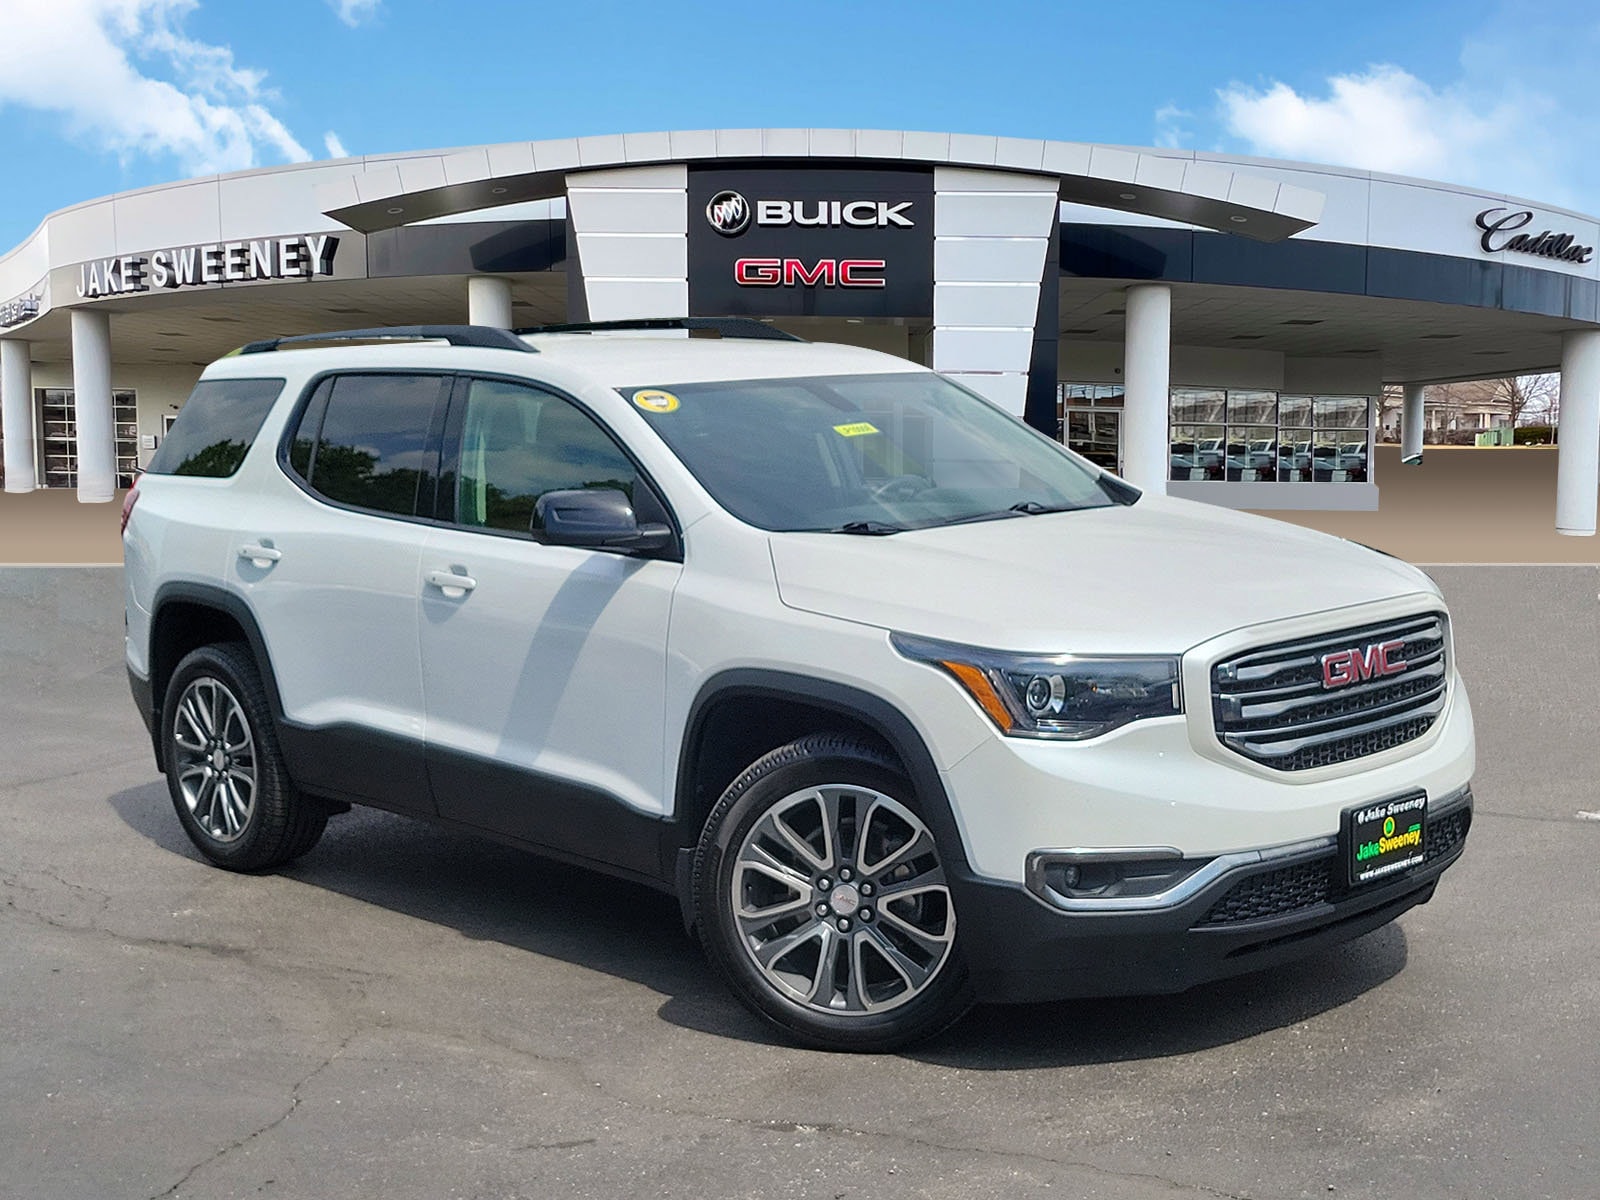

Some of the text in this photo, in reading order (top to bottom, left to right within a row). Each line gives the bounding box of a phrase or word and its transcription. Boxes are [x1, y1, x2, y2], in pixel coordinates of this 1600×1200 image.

[757, 200, 915, 227] BUICK
[1475, 207, 1593, 264] Cadillac
[76, 234, 330, 298] JAKE SWEENEY
[735, 258, 886, 287] GMC
[1321, 639, 1408, 690] GMC
[1364, 797, 1426, 823] Jake Sweeney
